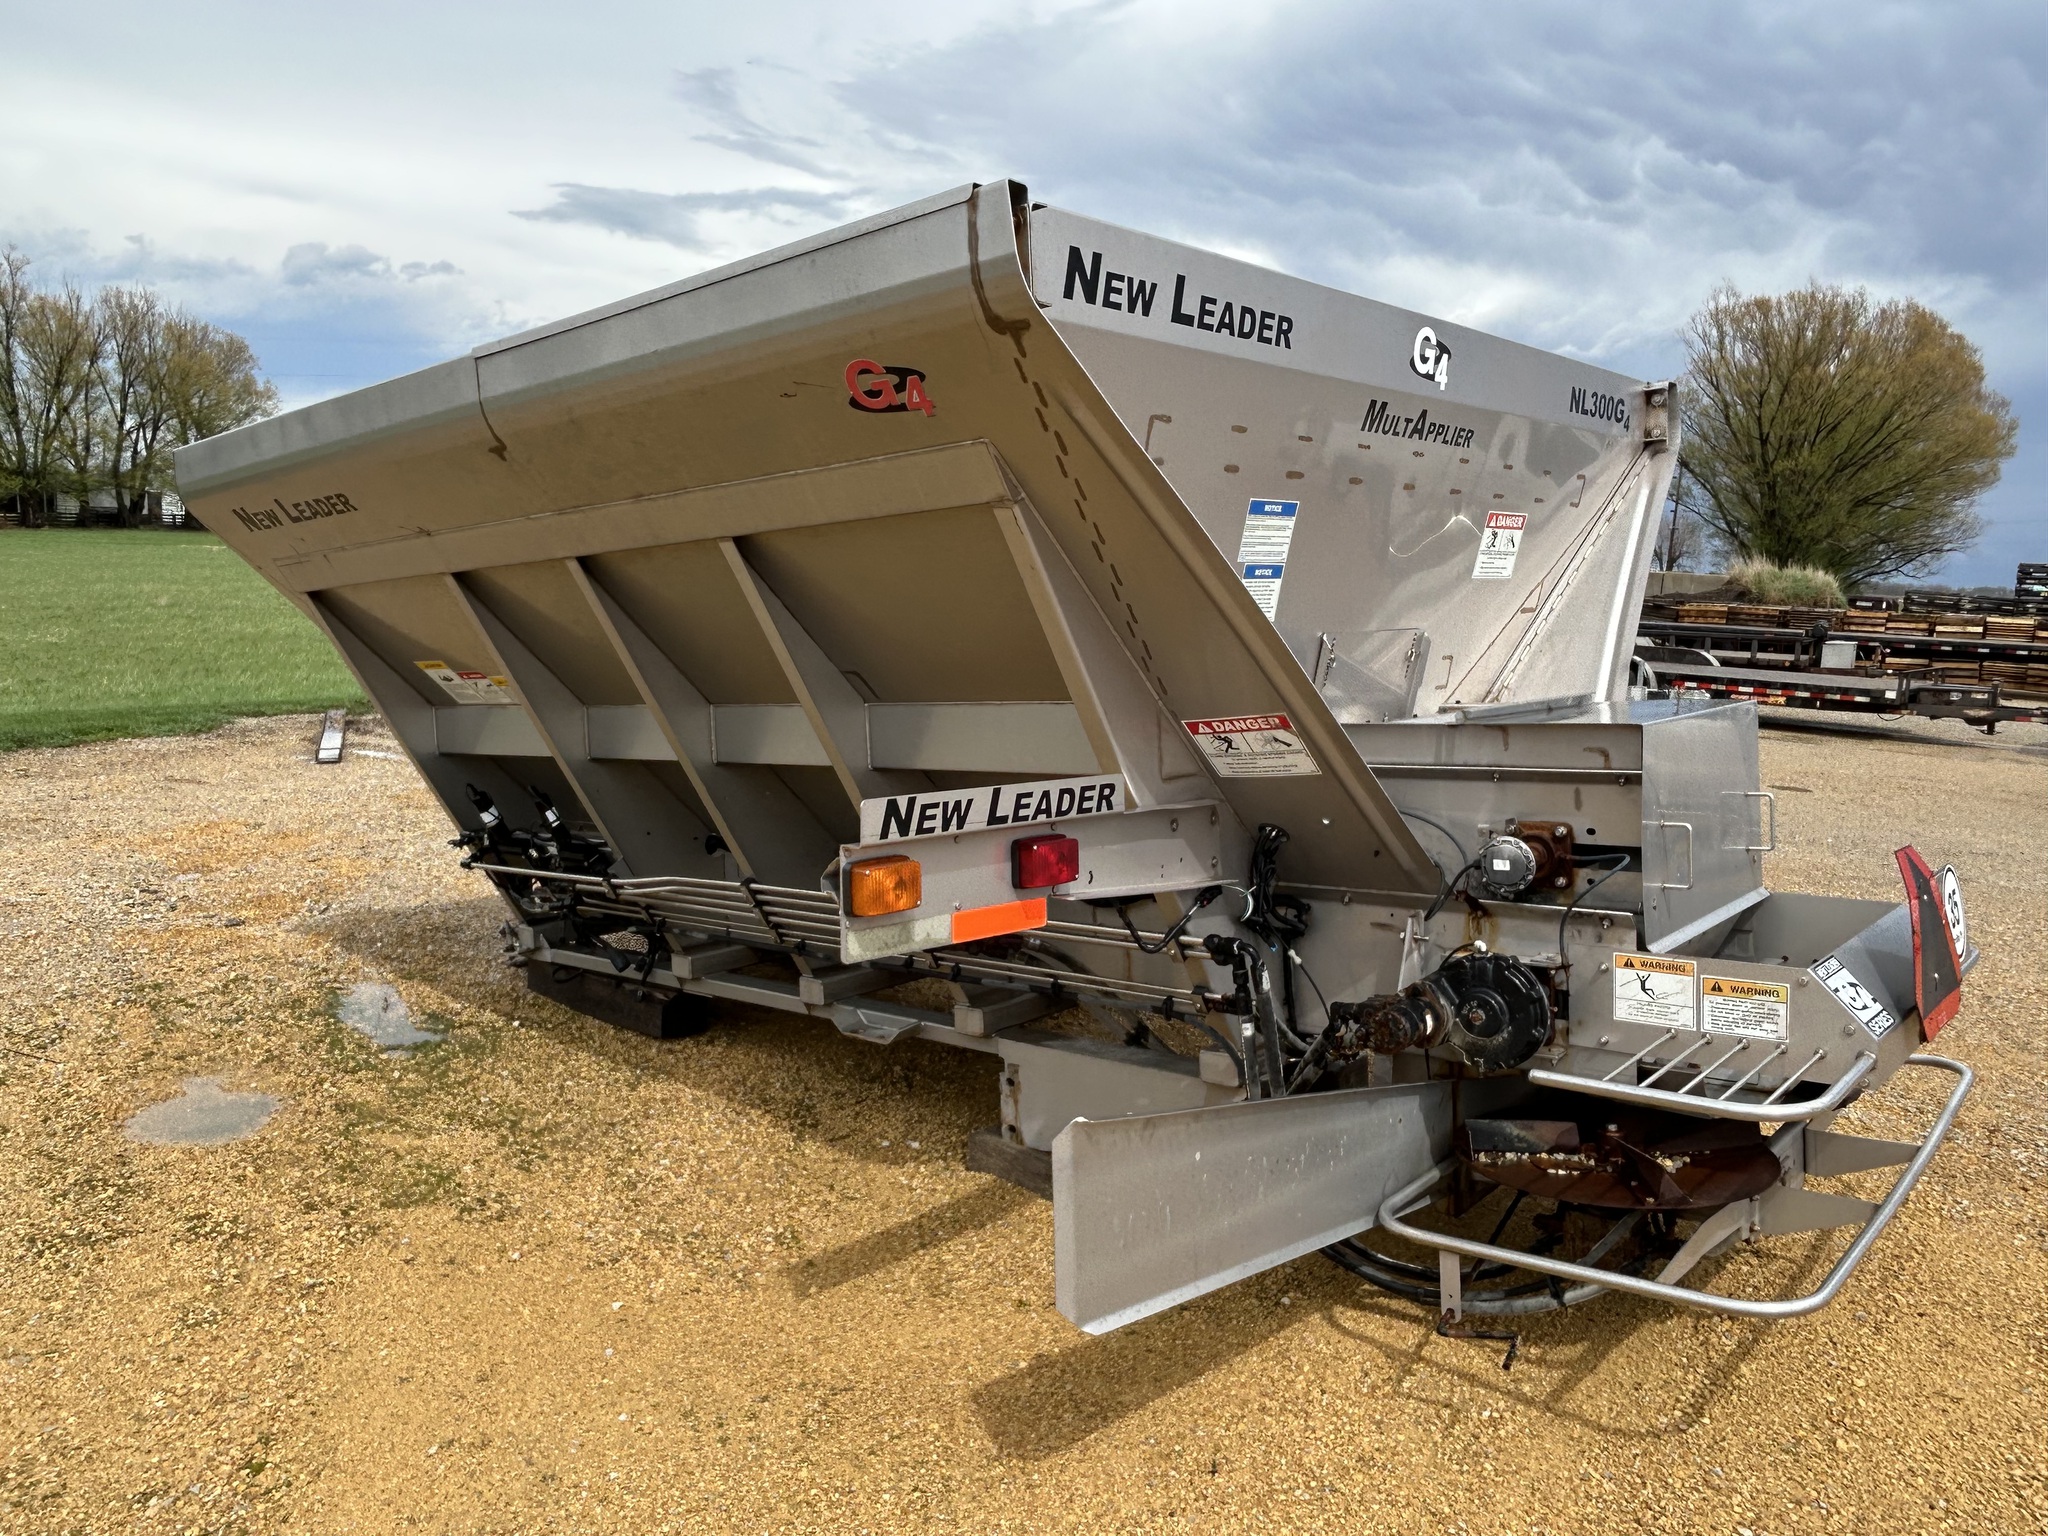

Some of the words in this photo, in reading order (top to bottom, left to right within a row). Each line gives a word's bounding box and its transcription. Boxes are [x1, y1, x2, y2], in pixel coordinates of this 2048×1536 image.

[1063, 245, 1158, 317] NEW
[1171, 273, 1294, 350] LEADER
[232, 507, 284, 532] NEW
[274, 493, 358, 524] LEADER
[1497, 515, 1524, 528] DANGER
[1212, 717, 1282, 732] DANGER
[879, 796, 974, 840] NEW
[986, 783, 1116, 827] LEADER
[1640, 960, 1686, 973] WARNING
[1730, 985, 1780, 998] WARNING
